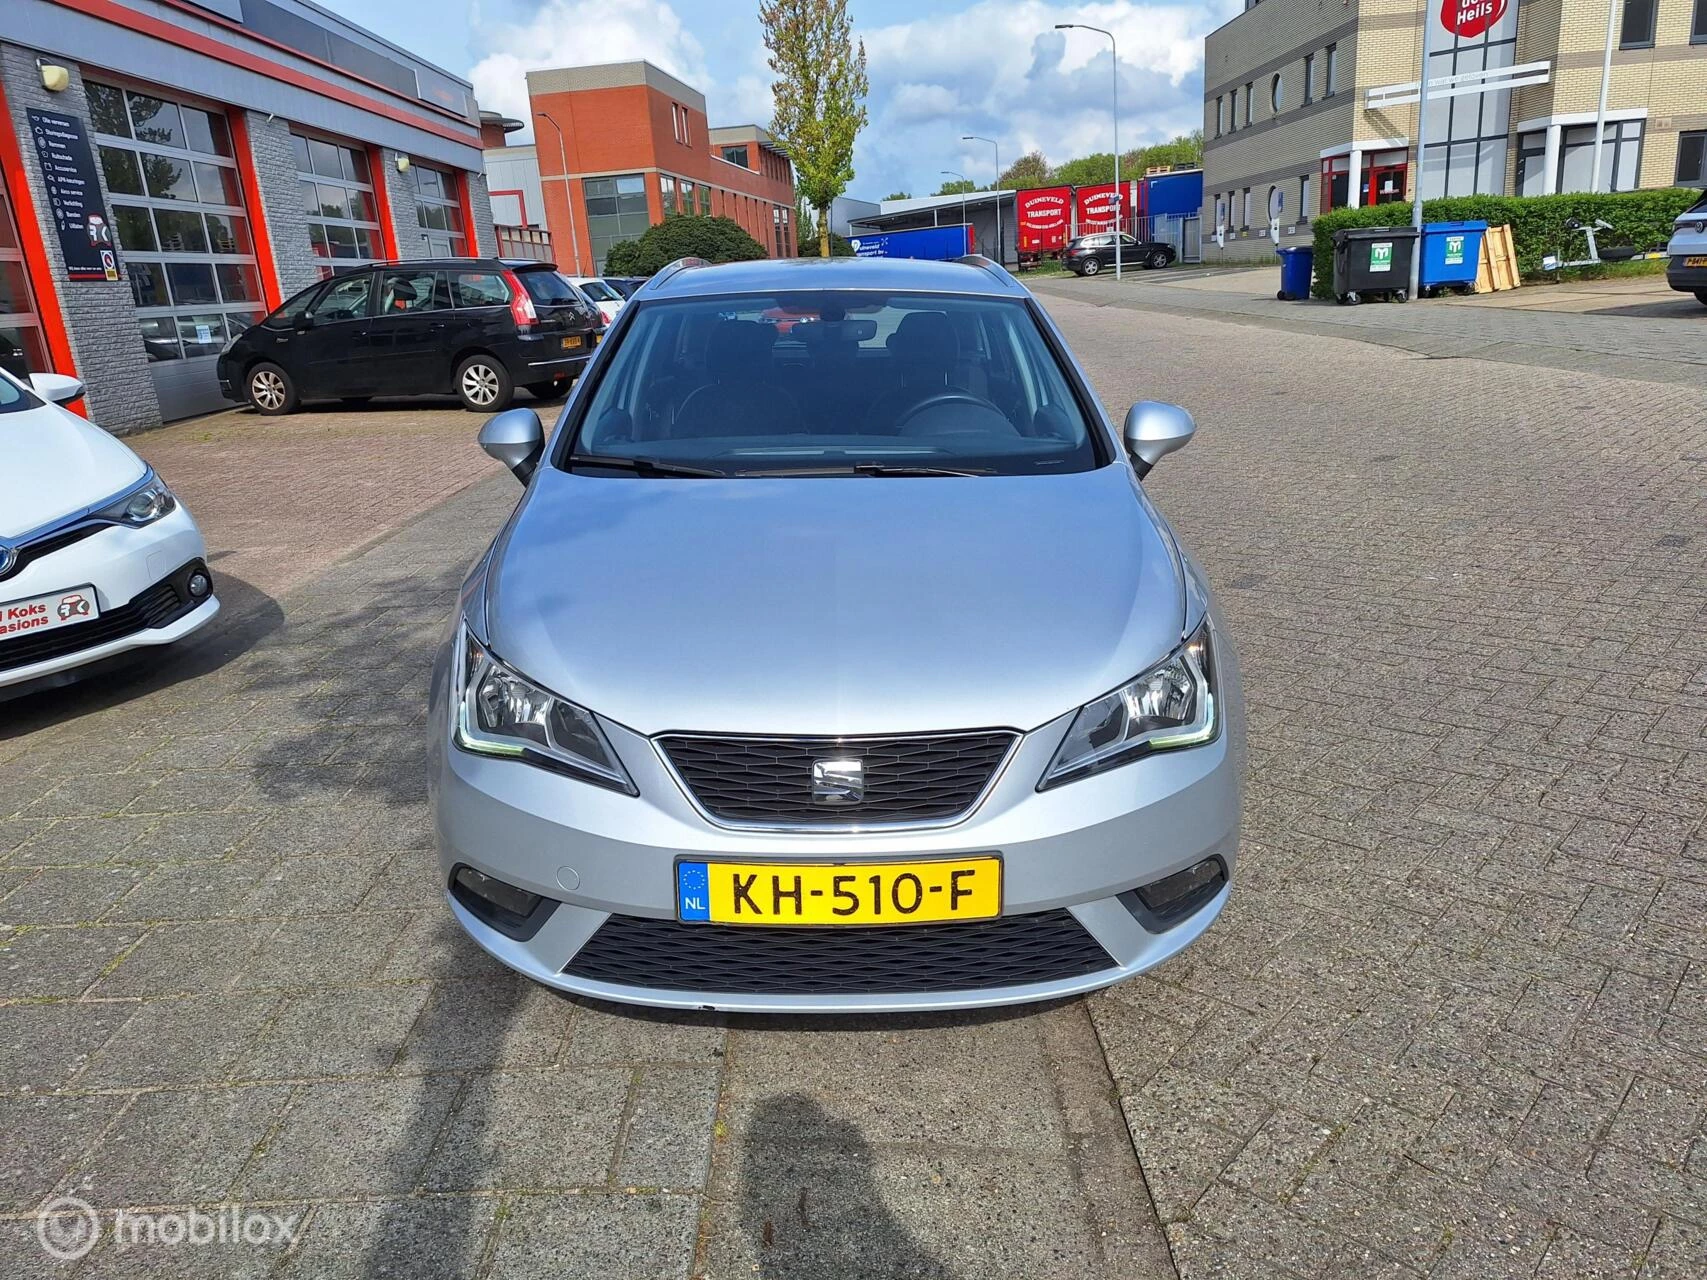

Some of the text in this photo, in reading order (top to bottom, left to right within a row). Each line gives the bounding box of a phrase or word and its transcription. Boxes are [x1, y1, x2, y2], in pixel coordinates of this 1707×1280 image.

[1456, 2, 1493, 26] Heils
[1024, 196, 1065, 209] DUINEVELD
[1026, 208, 1062, 218] TRANSPORT
[7, 604, 46, 620] Koks
[732, 869, 976, 917] KH-510-F
[685, 897, 706, 910] NL
